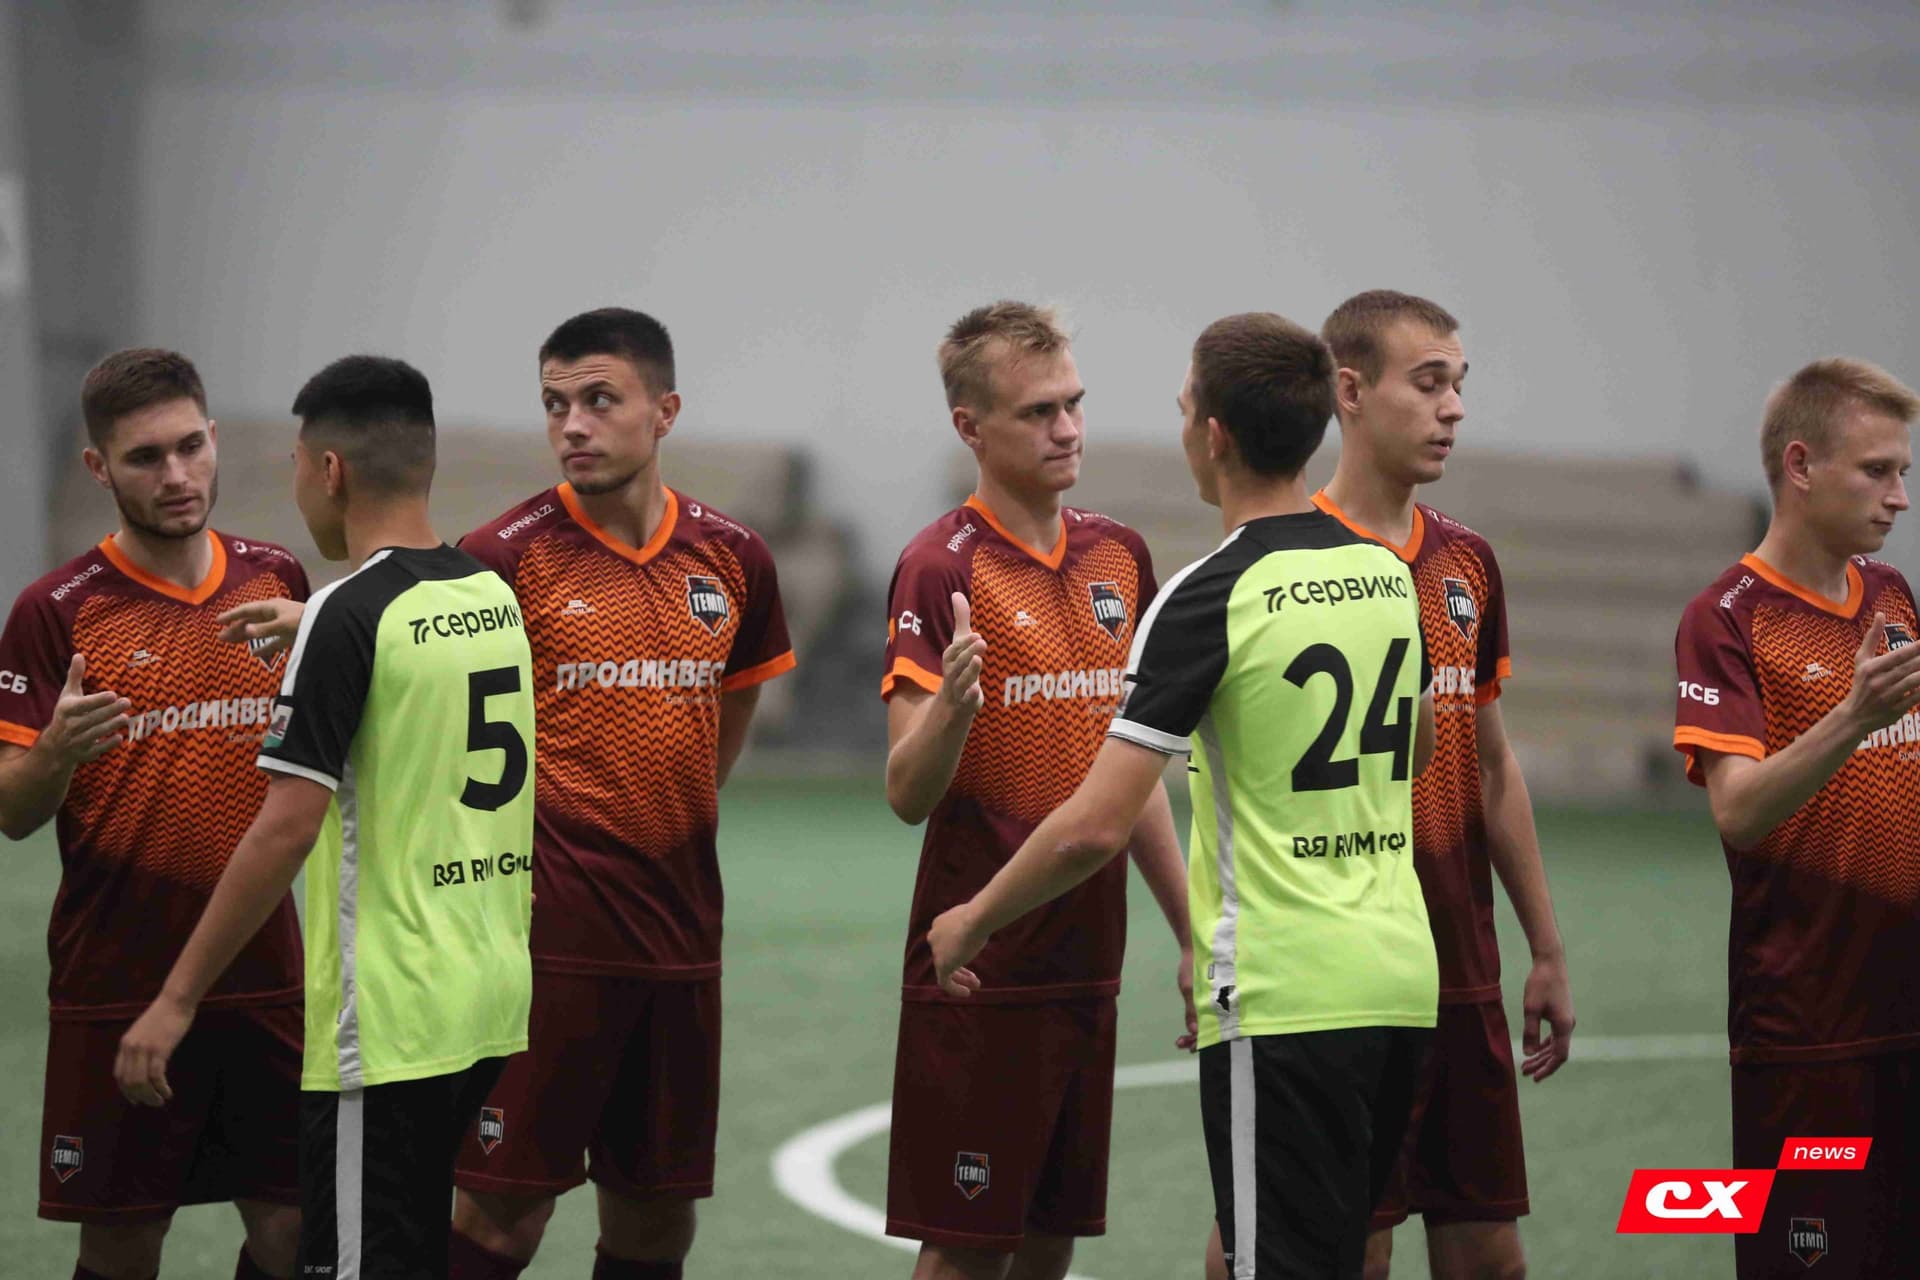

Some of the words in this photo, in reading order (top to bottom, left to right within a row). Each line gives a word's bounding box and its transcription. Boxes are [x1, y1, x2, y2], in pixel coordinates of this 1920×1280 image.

[692, 593, 726, 614] ТЕМП
[1094, 598, 1125, 621] ТЕМП
[1282, 638, 1413, 792] 24
[460, 666, 528, 812] 5
[959, 1165, 986, 1184] ТЕМП
[1793, 1232, 1823, 1249] ТЕМП
